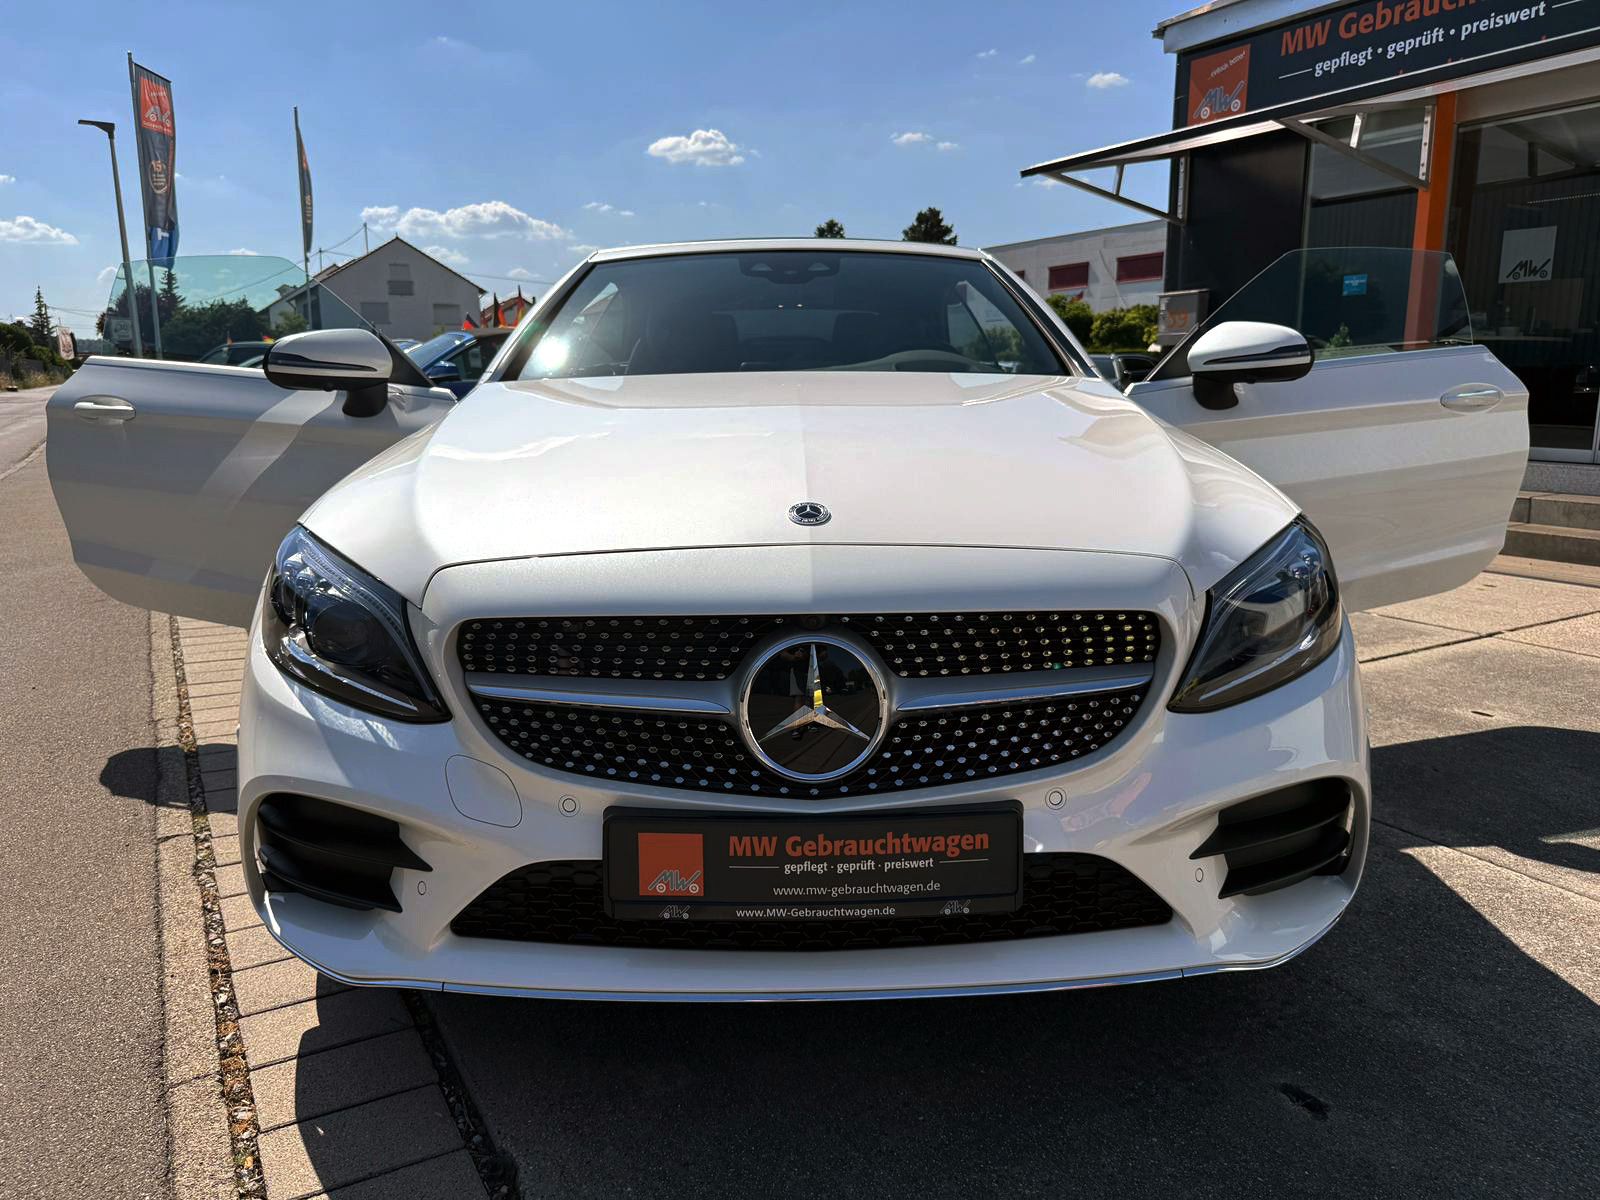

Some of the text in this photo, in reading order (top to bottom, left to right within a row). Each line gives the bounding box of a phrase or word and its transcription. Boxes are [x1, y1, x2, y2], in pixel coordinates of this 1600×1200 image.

[1280, 18, 1332, 57] MW
[1314, 1, 1547, 77] gepflegt geprüft preiswert
[728, 832, 989, 858] MW Gebrauchtwagen
[784, 857, 934, 875] gepflegt geprüft preiswert
[772, 880, 941, 898] www.mw-gebrauchtwagen.de
[735, 906, 896, 919] www.MW-Gebrauchtwagen.de
